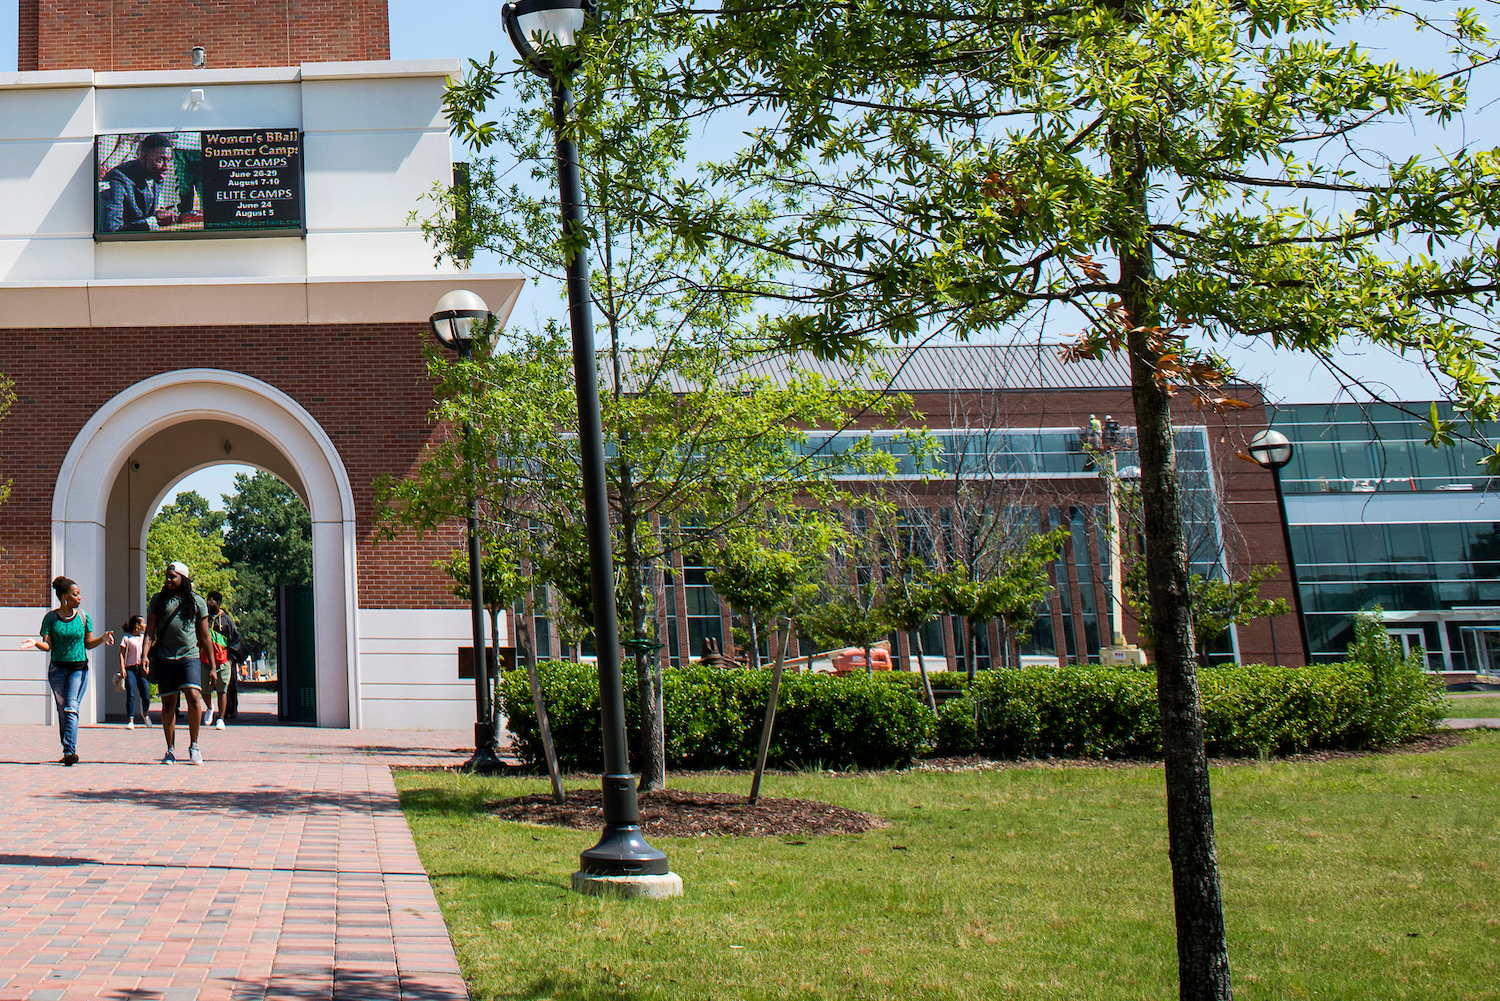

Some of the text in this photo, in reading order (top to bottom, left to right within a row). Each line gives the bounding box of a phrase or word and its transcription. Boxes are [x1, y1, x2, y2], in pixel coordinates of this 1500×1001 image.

[206, 131, 298, 144] Women's BBall
[205, 146, 256, 158] Summer
[219, 157, 287, 168] DAY CAMPS
[228, 179, 258, 187] August
[216, 189, 293, 200] ELITE CAMPS
[235, 210, 266, 218] August
